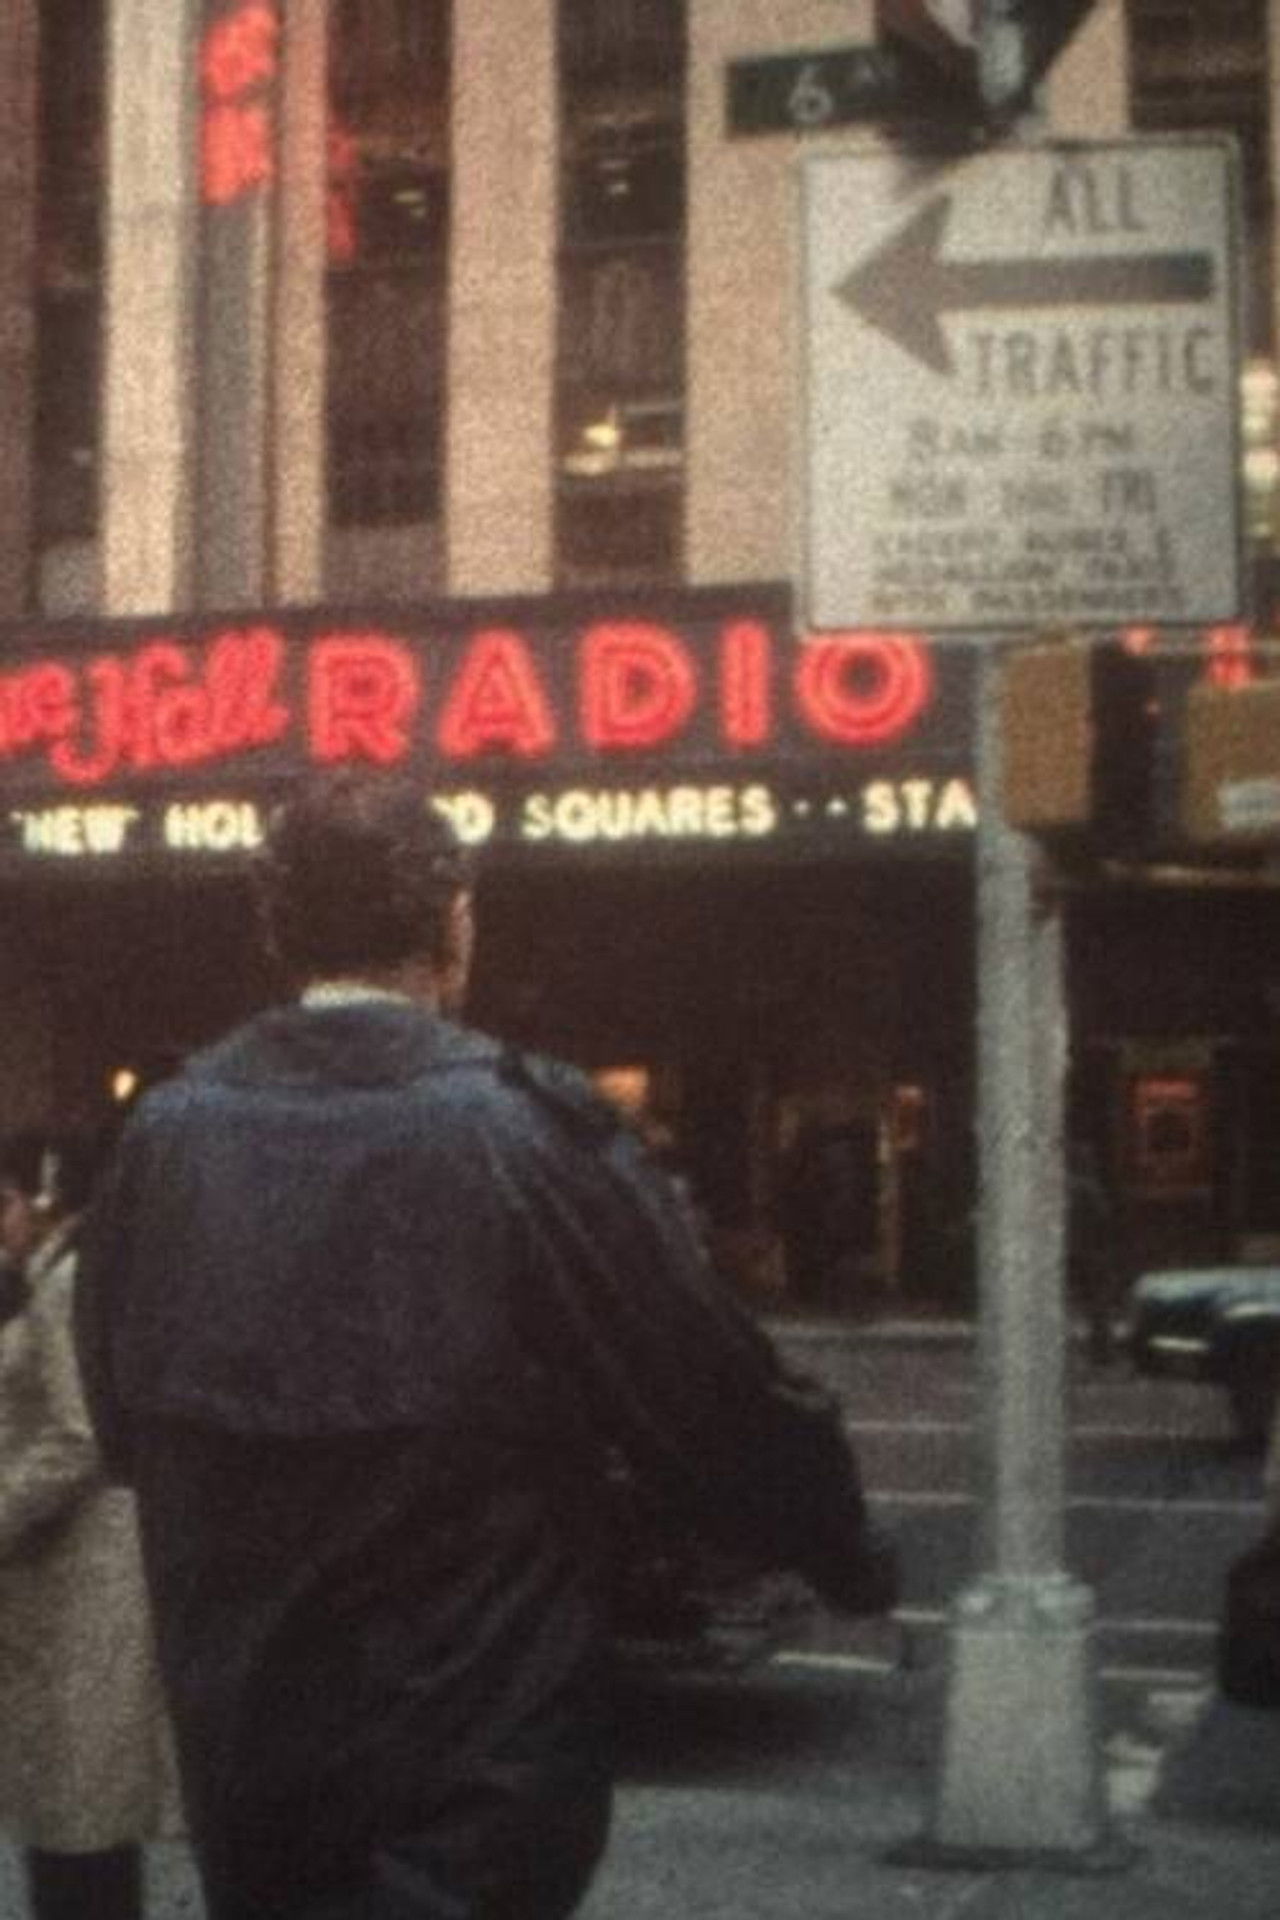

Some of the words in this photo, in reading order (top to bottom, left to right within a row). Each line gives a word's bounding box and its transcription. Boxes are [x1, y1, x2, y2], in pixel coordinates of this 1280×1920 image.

[786, 64, 834, 124] 6
[1043, 166, 1146, 234] ALL
[970, 326, 1215, 397] TRAFFIC
[305, 617, 930, 763] RADIO
[521, 784, 778, 841] SQUARES
